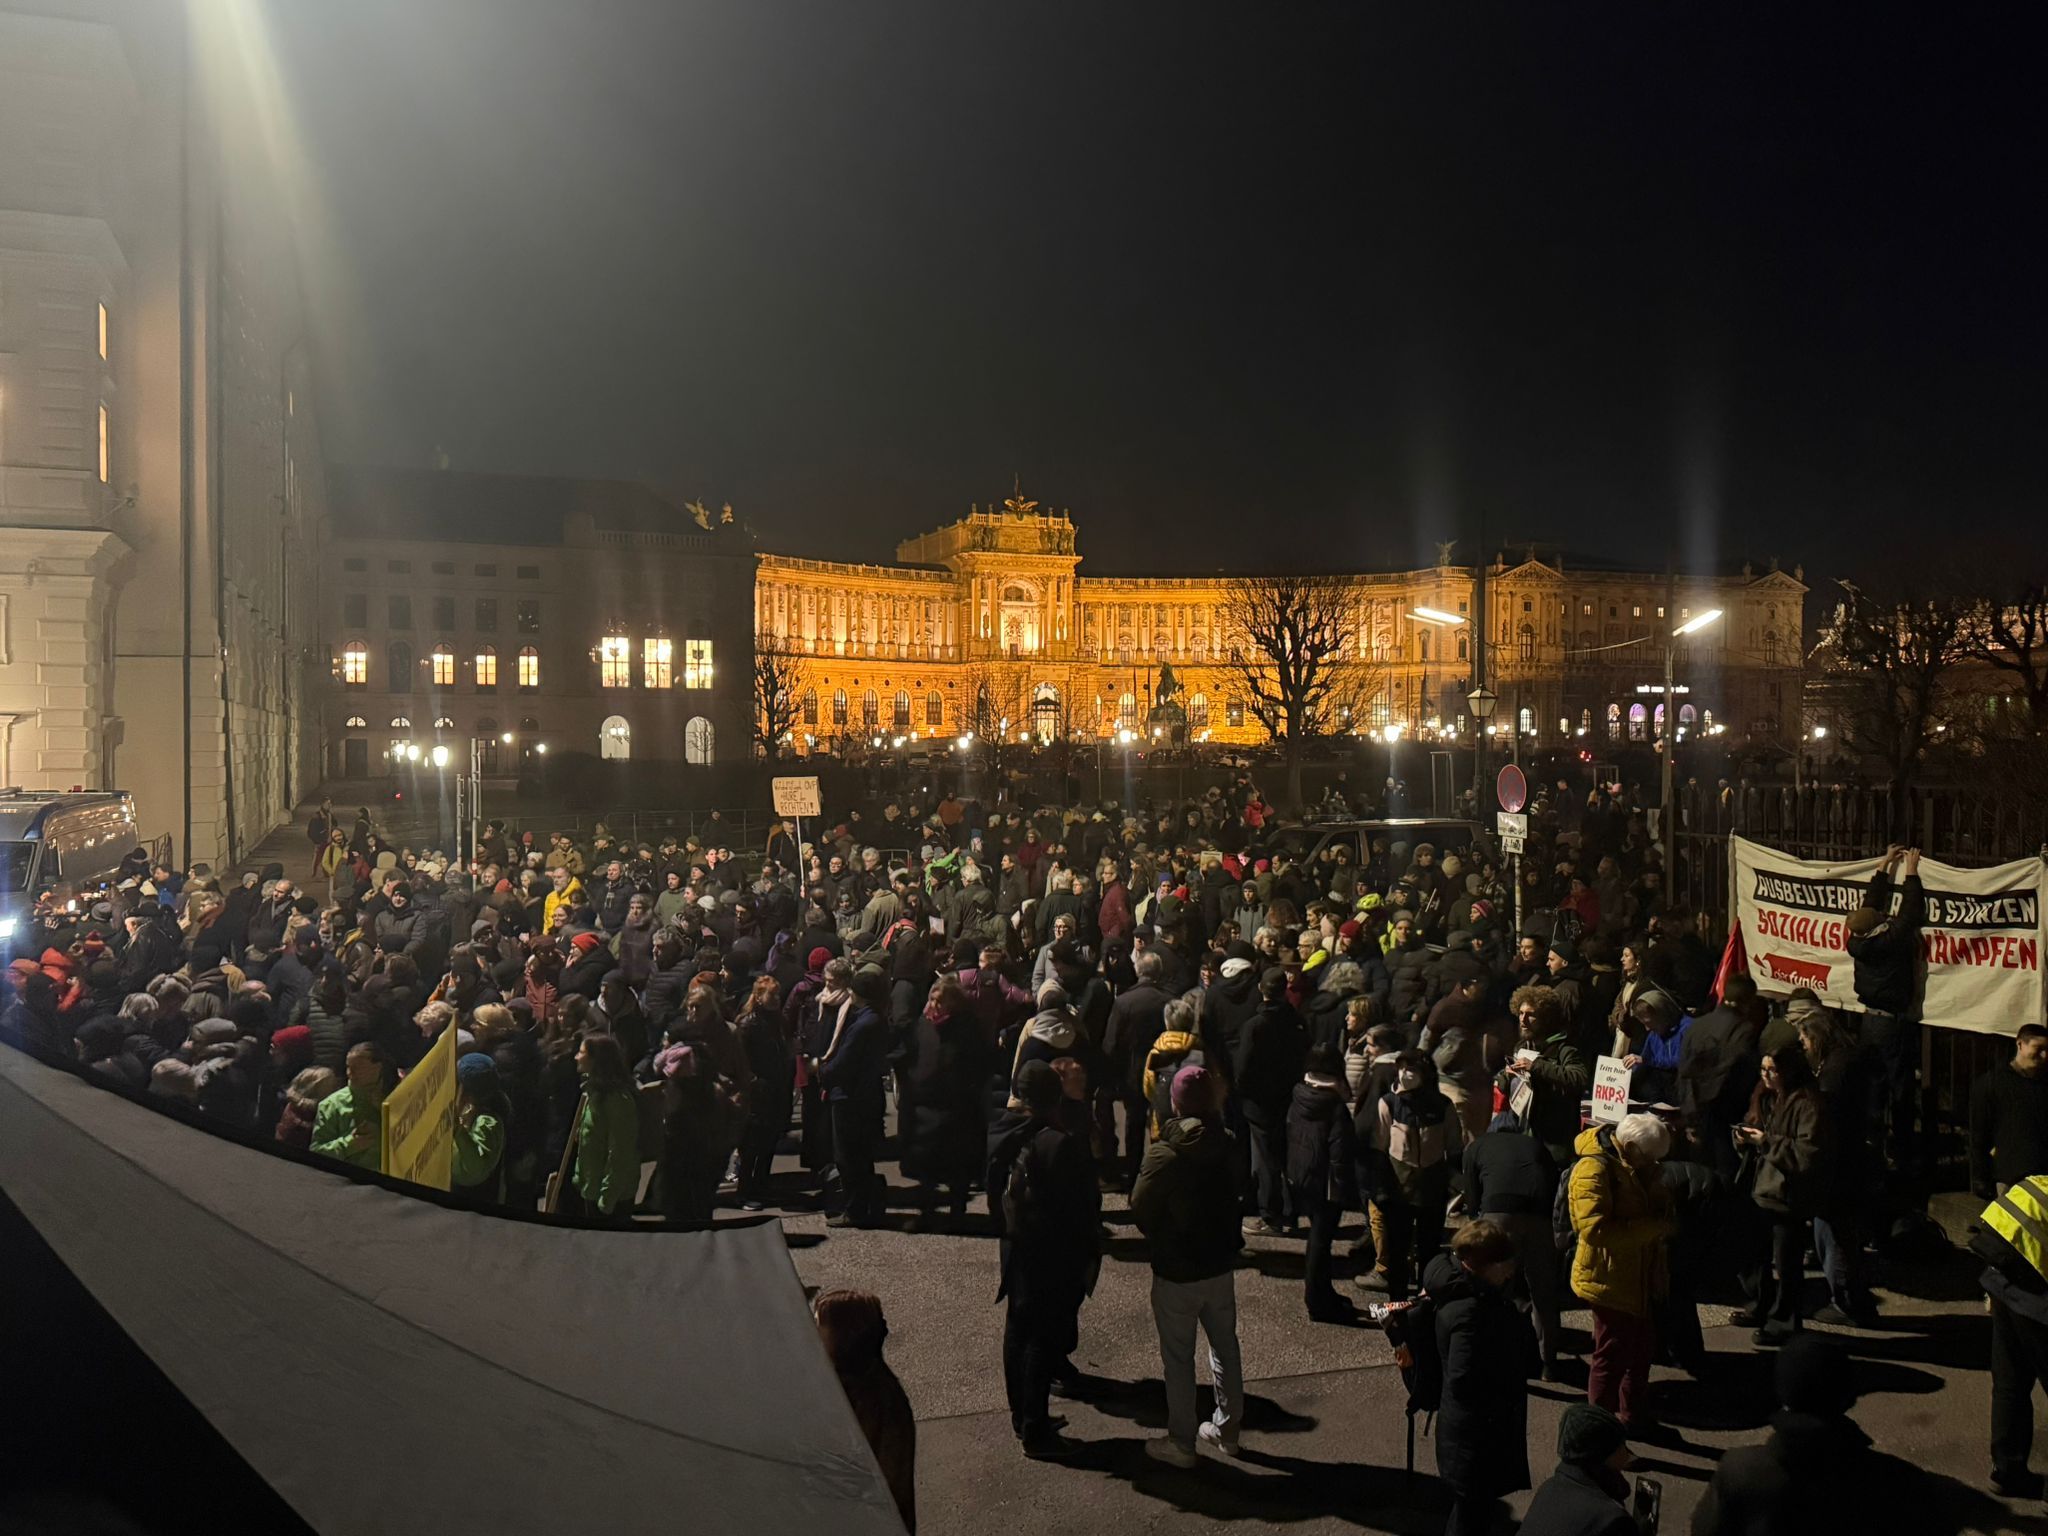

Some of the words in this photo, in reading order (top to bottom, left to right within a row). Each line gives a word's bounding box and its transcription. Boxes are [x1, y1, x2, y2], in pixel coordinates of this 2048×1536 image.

[1945, 896, 2035, 924] STÜRZEN
[1789, 971, 1826, 991] funke
[1595, 1084, 1616, 1101] RKP
[1603, 1103, 1615, 1111] bei
